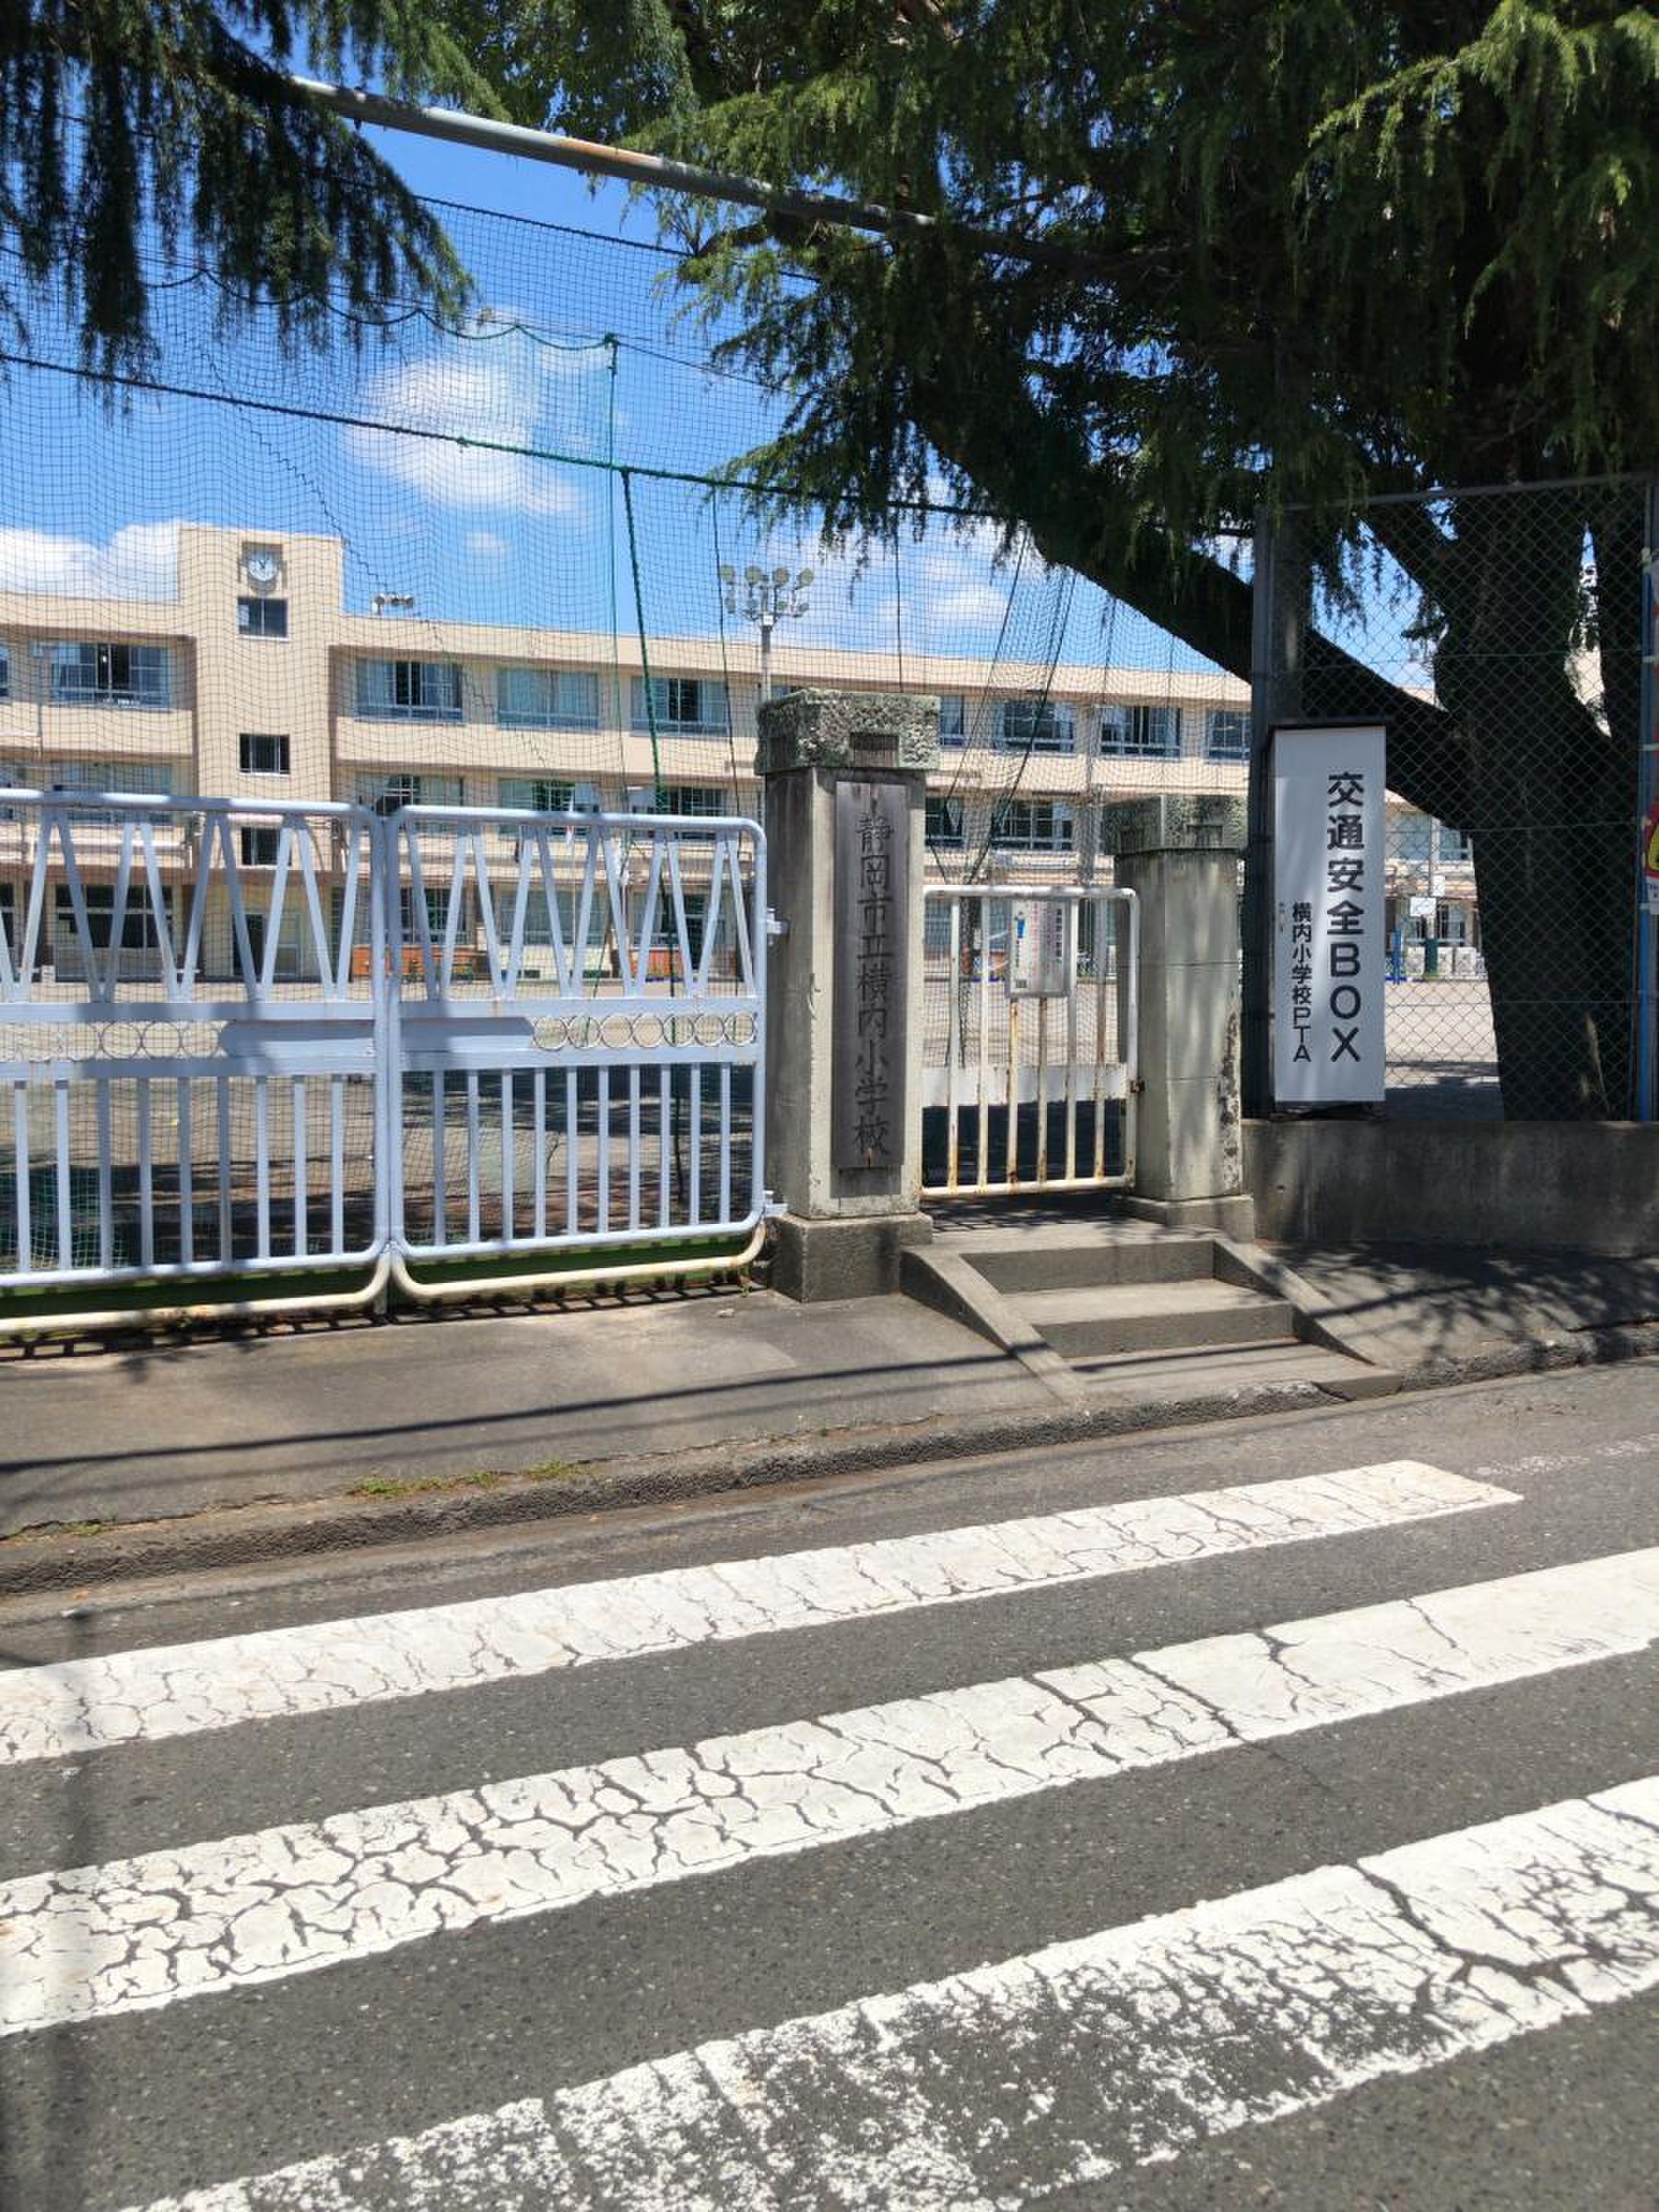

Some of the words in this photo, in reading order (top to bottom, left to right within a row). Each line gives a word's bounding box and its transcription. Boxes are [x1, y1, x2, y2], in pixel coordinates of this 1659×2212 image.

[853, 812, 895, 1155] 静岡市立横内小学校
[1291, 901, 1312, 1063] 横内小学校PTA
[1326, 771, 1365, 1063] 交通安全BOX
